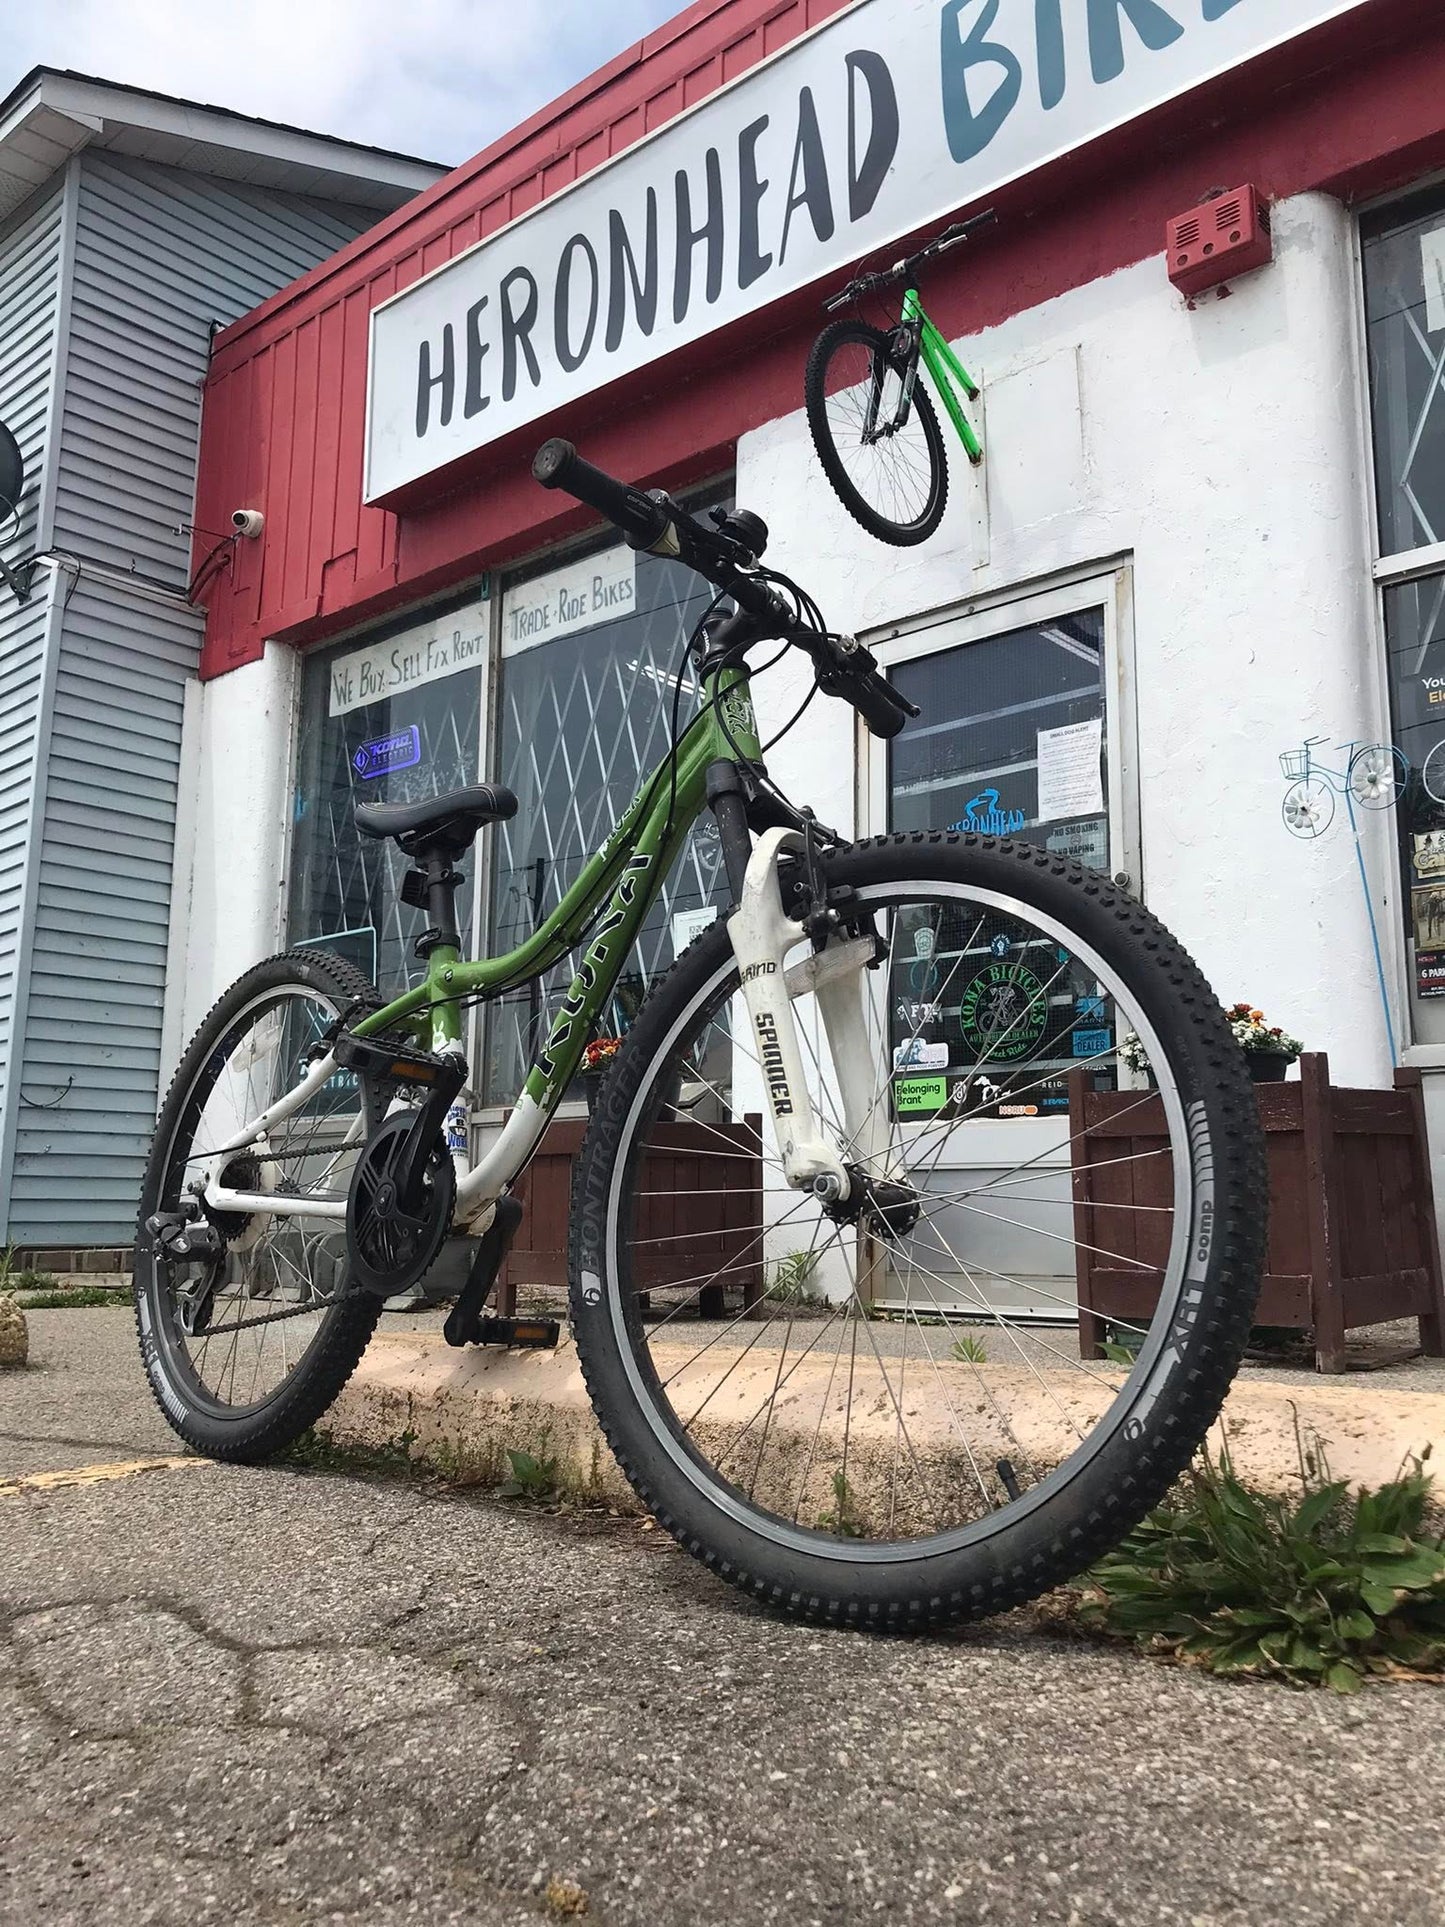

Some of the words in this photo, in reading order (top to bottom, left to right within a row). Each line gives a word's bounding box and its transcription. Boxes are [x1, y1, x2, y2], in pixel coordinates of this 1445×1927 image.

[416, 49, 898, 438] HERONHEAD
[940, 0, 1241, 164] BIK
[509, 605, 550, 640] TRADE
[559, 588, 587, 623] RIDE
[592, 576, 633, 611] BIKES
[333, 668, 352, 706] WE
[359, 661, 385, 698] BUY
[389, 650, 421, 685] SELL
[427, 639, 448, 671] FIX
[453, 631, 484, 662] RENT
[1054, 827, 1064, 838] NO
[1065, 822, 1099, 837] SMOKING
[1069, 843, 1095, 855] VAPING
[1421, 969, 1428, 978] 6
[962, 978, 987, 1029] KONA
[989, 964, 1046, 1025] BICYCLES
[1012, 1030, 1039, 1040] DEALER
[1077, 1041, 1106, 1052] DEALER
[756, 1012, 793, 1119] SPINNER
[896, 1083, 941, 1095] Belonging
[897, 1095, 922, 1106] Brant
[581, 1045, 643, 1274] BONTRAGER
[1197, 1200, 1214, 1262] comp
